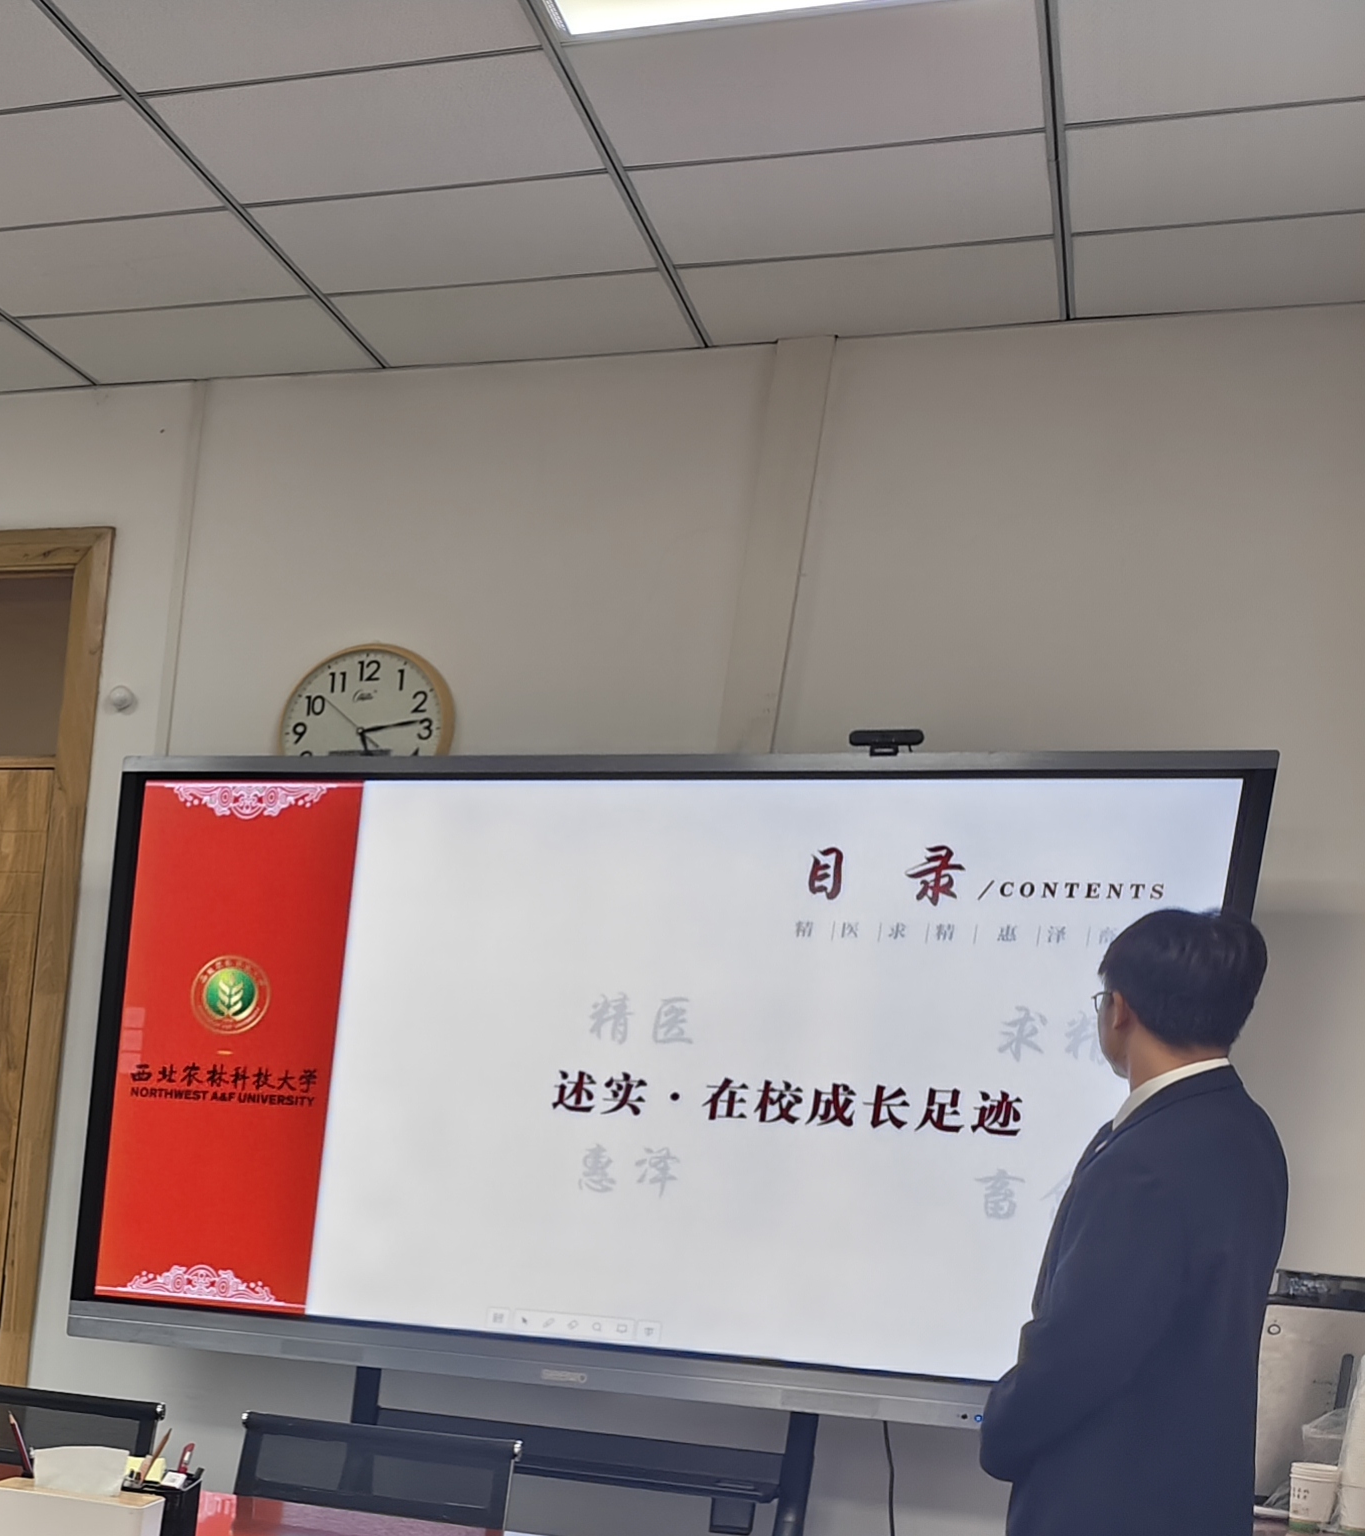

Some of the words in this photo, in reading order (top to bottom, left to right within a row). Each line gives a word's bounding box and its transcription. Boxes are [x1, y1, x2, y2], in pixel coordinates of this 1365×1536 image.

[329, 671, 347, 693] 11
[358, 660, 381, 682] 12
[397, 668, 405, 691] 1
[305, 695, 325, 716] 10
[411, 691, 428, 713] 2
[292, 722, 307, 745] 9
[417, 718, 433, 740] 3
[130, 1062, 318, 1093] 西北农林科技大学
[130, 1086, 209, 1101] NORTHWEST
[210, 1090, 235, 1103] A&F
[238, 1092, 316, 1107] UNIVERSITY
